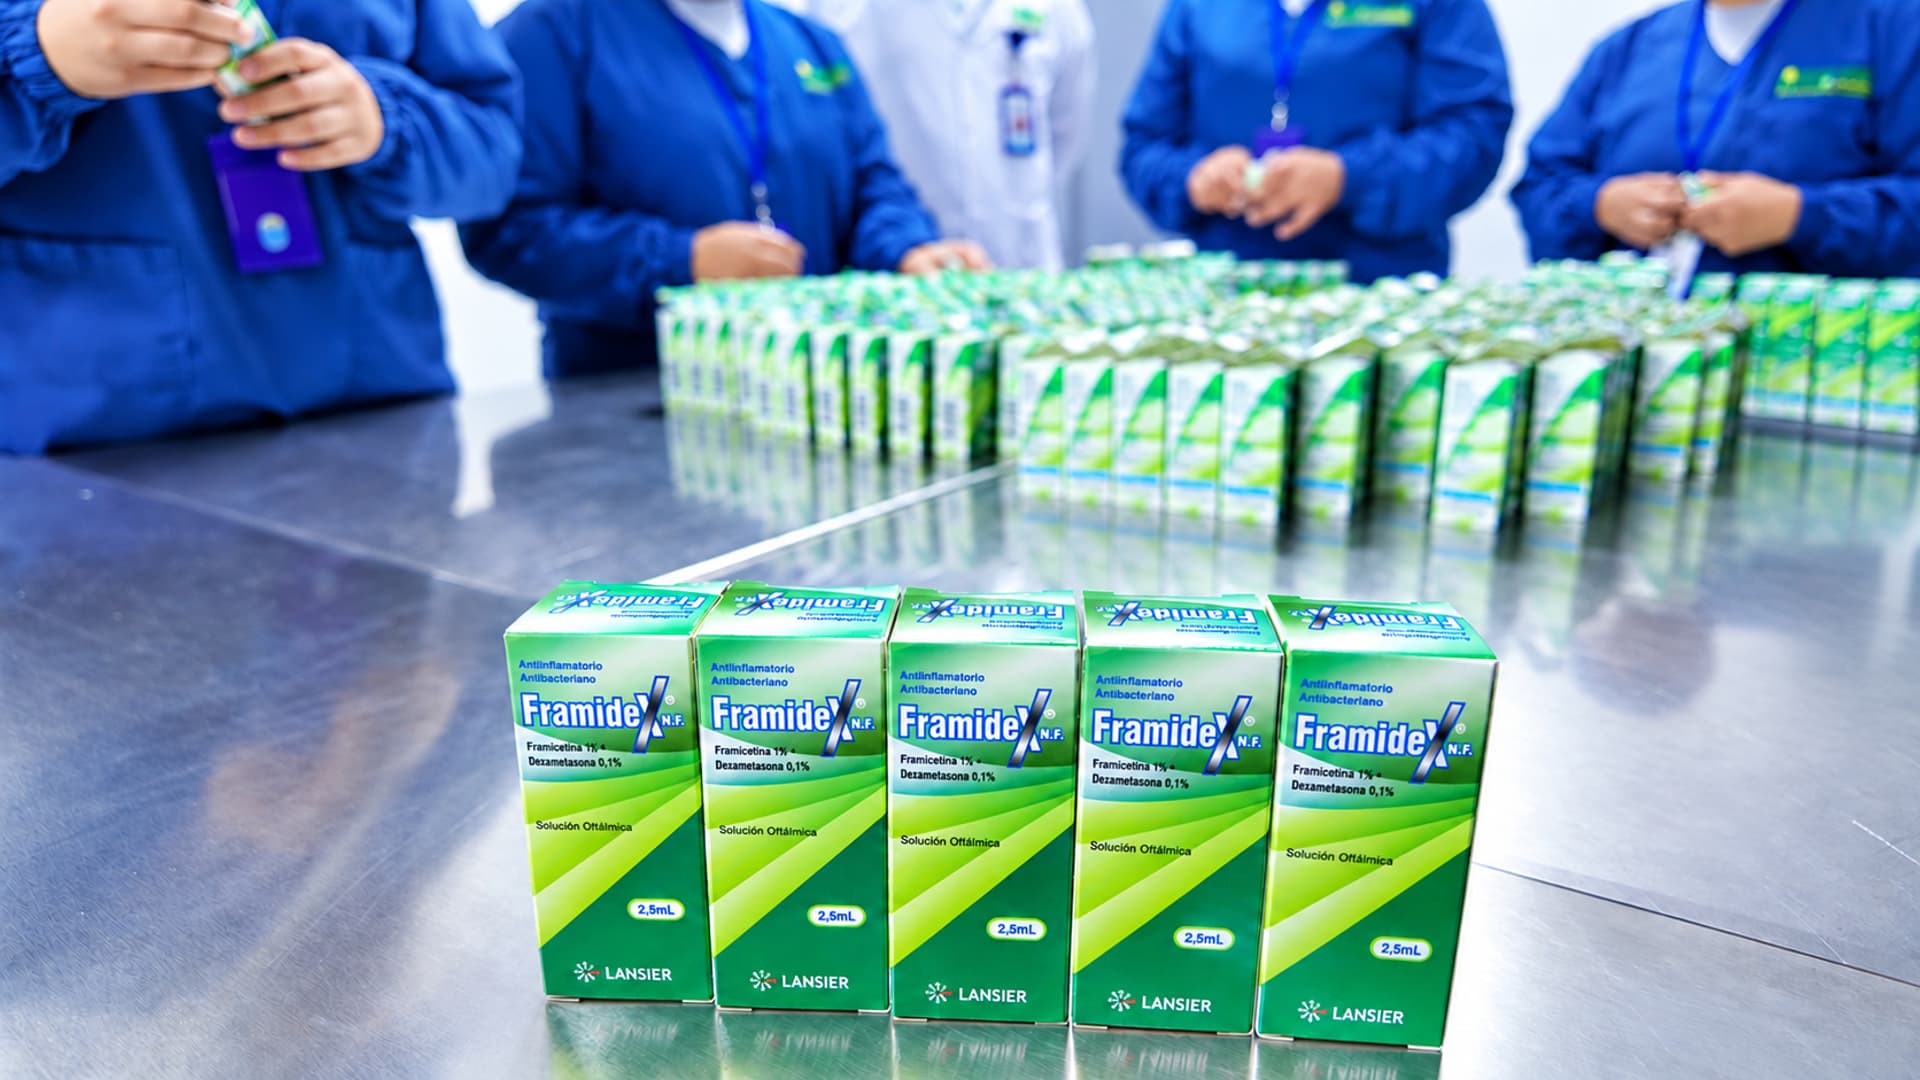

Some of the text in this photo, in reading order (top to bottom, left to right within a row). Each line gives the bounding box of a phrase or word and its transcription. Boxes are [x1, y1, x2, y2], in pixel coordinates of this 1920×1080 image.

[519, 660, 603, 671] Antiinflamatorio
[711, 663, 795, 674] Antiinflamatorio
[520, 673, 596, 684] Antibacteriano
[711, 676, 788, 687] Antibacteriano
[900, 671, 985, 682] Antiinflamatorio
[1096, 675, 1183, 688] Antiinflamatorio
[900, 685, 977, 696] Antibacteriano
[1301, 679, 1393, 694] Antiinflamatorio
[1095, 688, 1175, 701] Antibacteriano
[1299, 693, 1383, 707] Antibacteriano
[661, 715, 685, 727] N.F.
[851, 718, 875, 730] N.F.
[1040, 728, 1064, 740] N.F.
[527, 742, 582, 752] Framicetina
[586, 743, 598, 753] 1%
[1237, 736, 1262, 748] N.F.
[715, 745, 771, 756] Framicetina
[774, 747, 787, 756] 1%
[1448, 744, 1472, 756] N.F.
[528, 756, 622, 768] Dexametasona 0,1%
[900, 754, 957, 765] Framicetina
[961, 756, 973, 766] 1%
[1093, 759, 1150, 771] Framicetina
[1153, 762, 1167, 772] 1%
[715, 760, 810, 773] Dexametasona 0,1%
[1293, 765, 1354, 779] Framicetina
[1358, 769, 1373, 780] 1%
[900, 769, 995, 782] Dexametasona 0,1%
[1092, 774, 1189, 789] Dexametasona 0,1%
[1292, 780, 1394, 797] Dexametasona 0,1%
[536, 820, 632, 832] Solución Oftálmica
[719, 825, 817, 837] Solución Oftálmica
[900, 835, 1000, 847] Solución Oftálmica
[1090, 841, 1192, 856] Solución Oftálmica
[1286, 848, 1393, 866] Solución Oftálmica
[637, 904, 675, 916] 2,5mL
[817, 911, 856, 922] 2,5mL
[998, 924, 1036, 936] 2,5mL
[1184, 933, 1223, 945] 2,5mL
[1381, 943, 1422, 956] 2,5mL
[605, 966, 672, 981] LANSIER
[781, 975, 849, 989] LANSIER
[959, 987, 1027, 1003] LANSIER
[1142, 995, 1211, 1013] LANSIER
[1332, 1006, 1404, 1024] LANSIER
